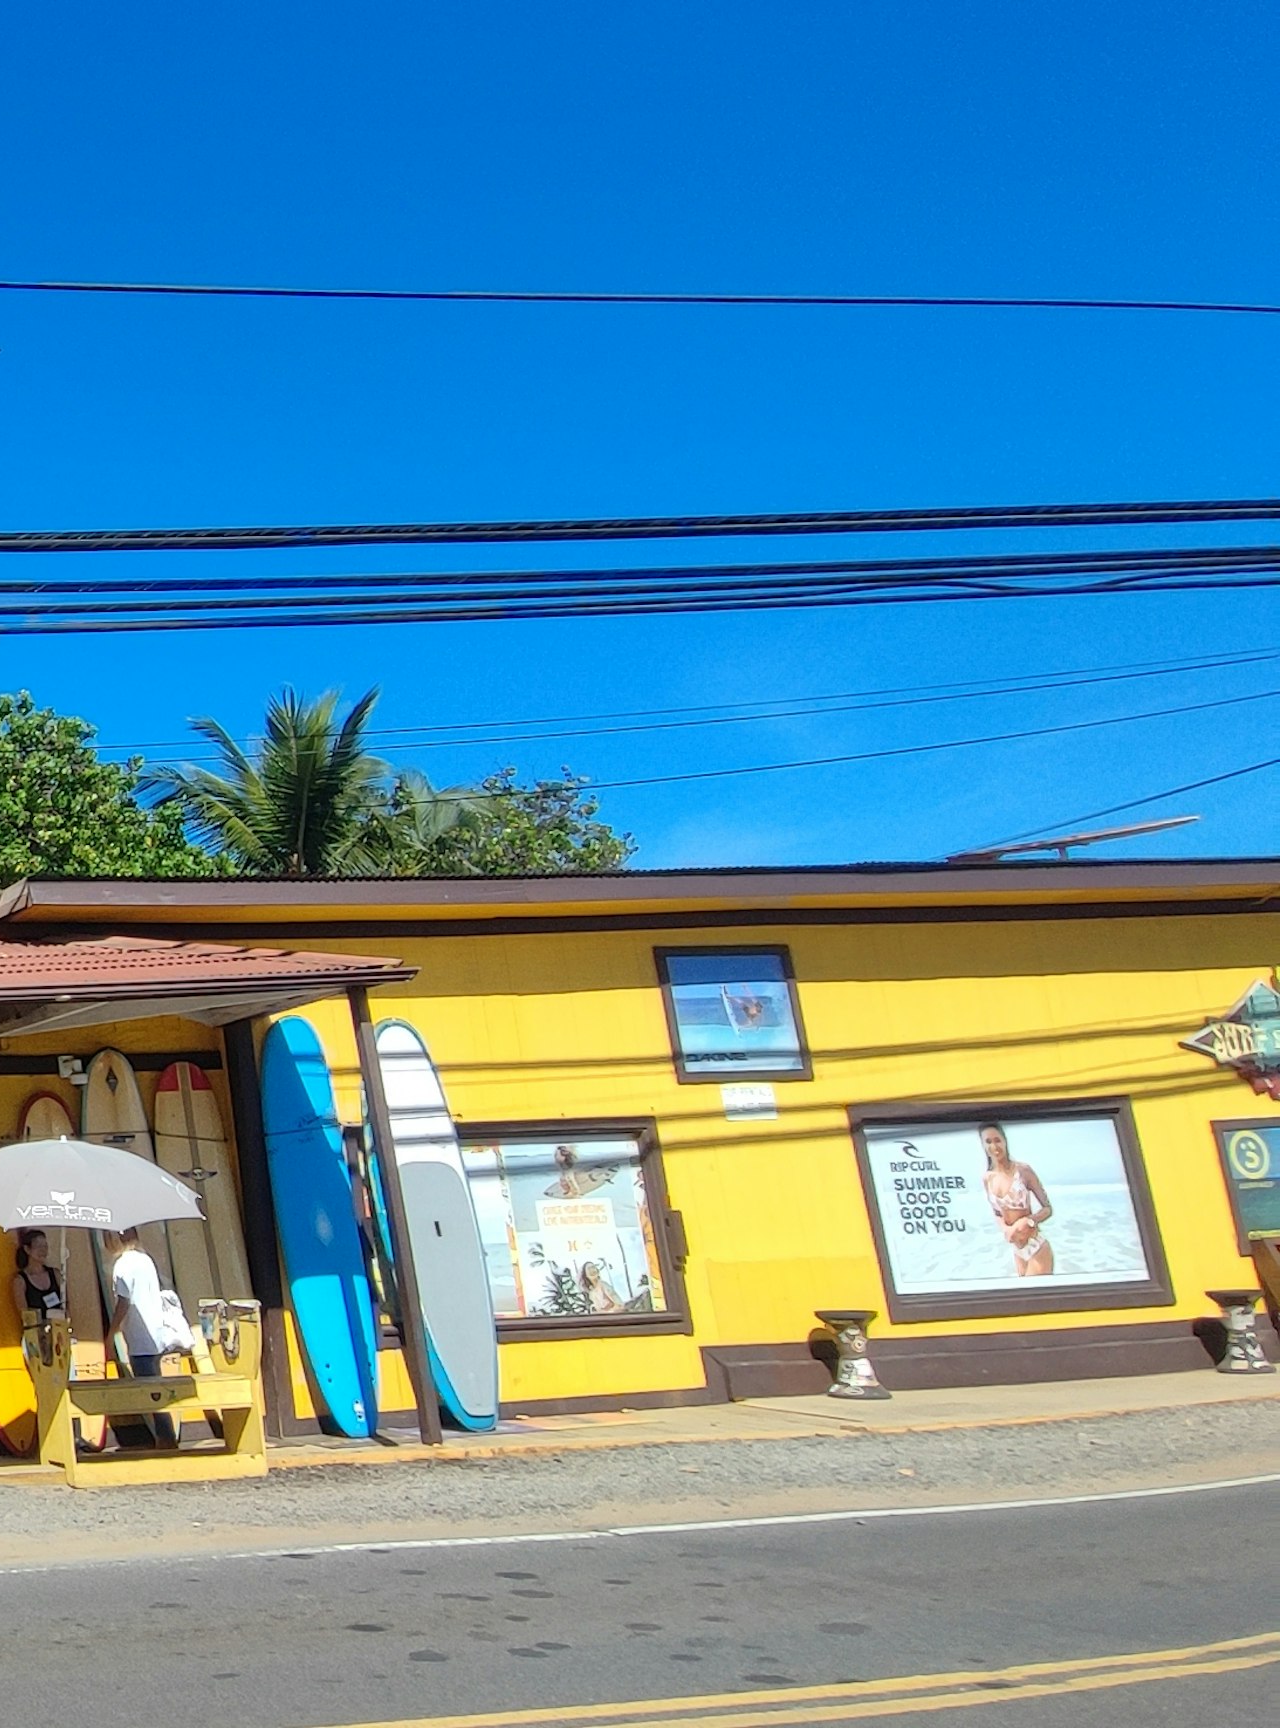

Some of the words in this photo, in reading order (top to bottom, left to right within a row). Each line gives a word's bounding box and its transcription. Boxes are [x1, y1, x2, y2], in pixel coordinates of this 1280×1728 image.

[890, 1162, 909, 1172] RIP
[910, 1161, 941, 1171] CURL
[894, 1176, 966, 1191] SUMMER
[897, 1191, 951, 1205] LOOKS
[16, 1204, 112, 1222] vertra
[901, 1206, 948, 1219] GOOD
[904, 1221, 928, 1234] ON
[931, 1219, 966, 1233] YOU
